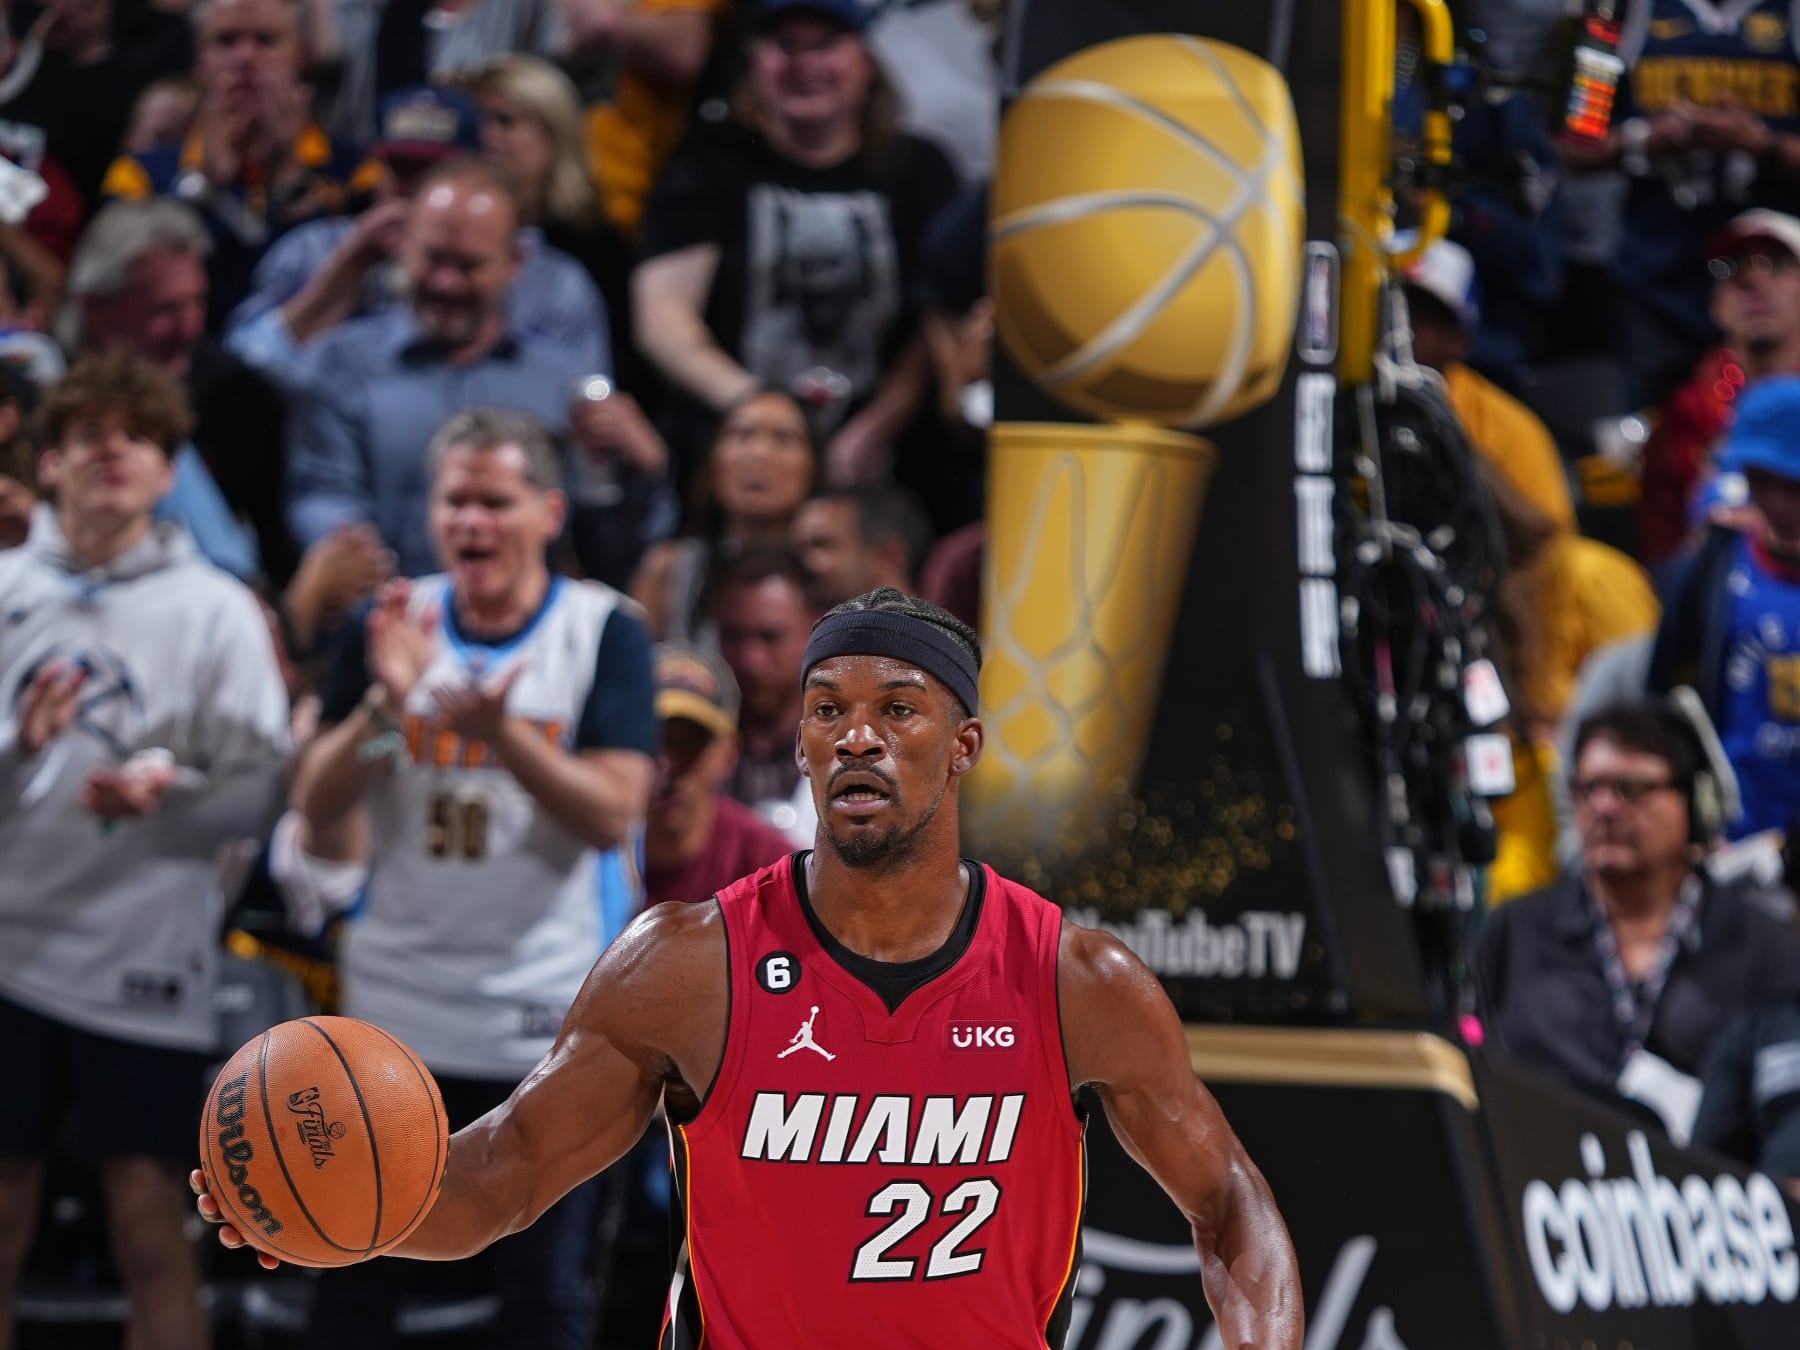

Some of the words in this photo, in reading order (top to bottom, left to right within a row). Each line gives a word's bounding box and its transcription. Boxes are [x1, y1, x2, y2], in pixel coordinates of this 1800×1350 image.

[766, 956, 791, 989] 6
[216, 1070, 284, 1238] Wilson
[740, 1090, 1026, 1166] MIAMI
[847, 1176, 1003, 1283] 22
[1522, 1128, 1800, 1315] coinbase
